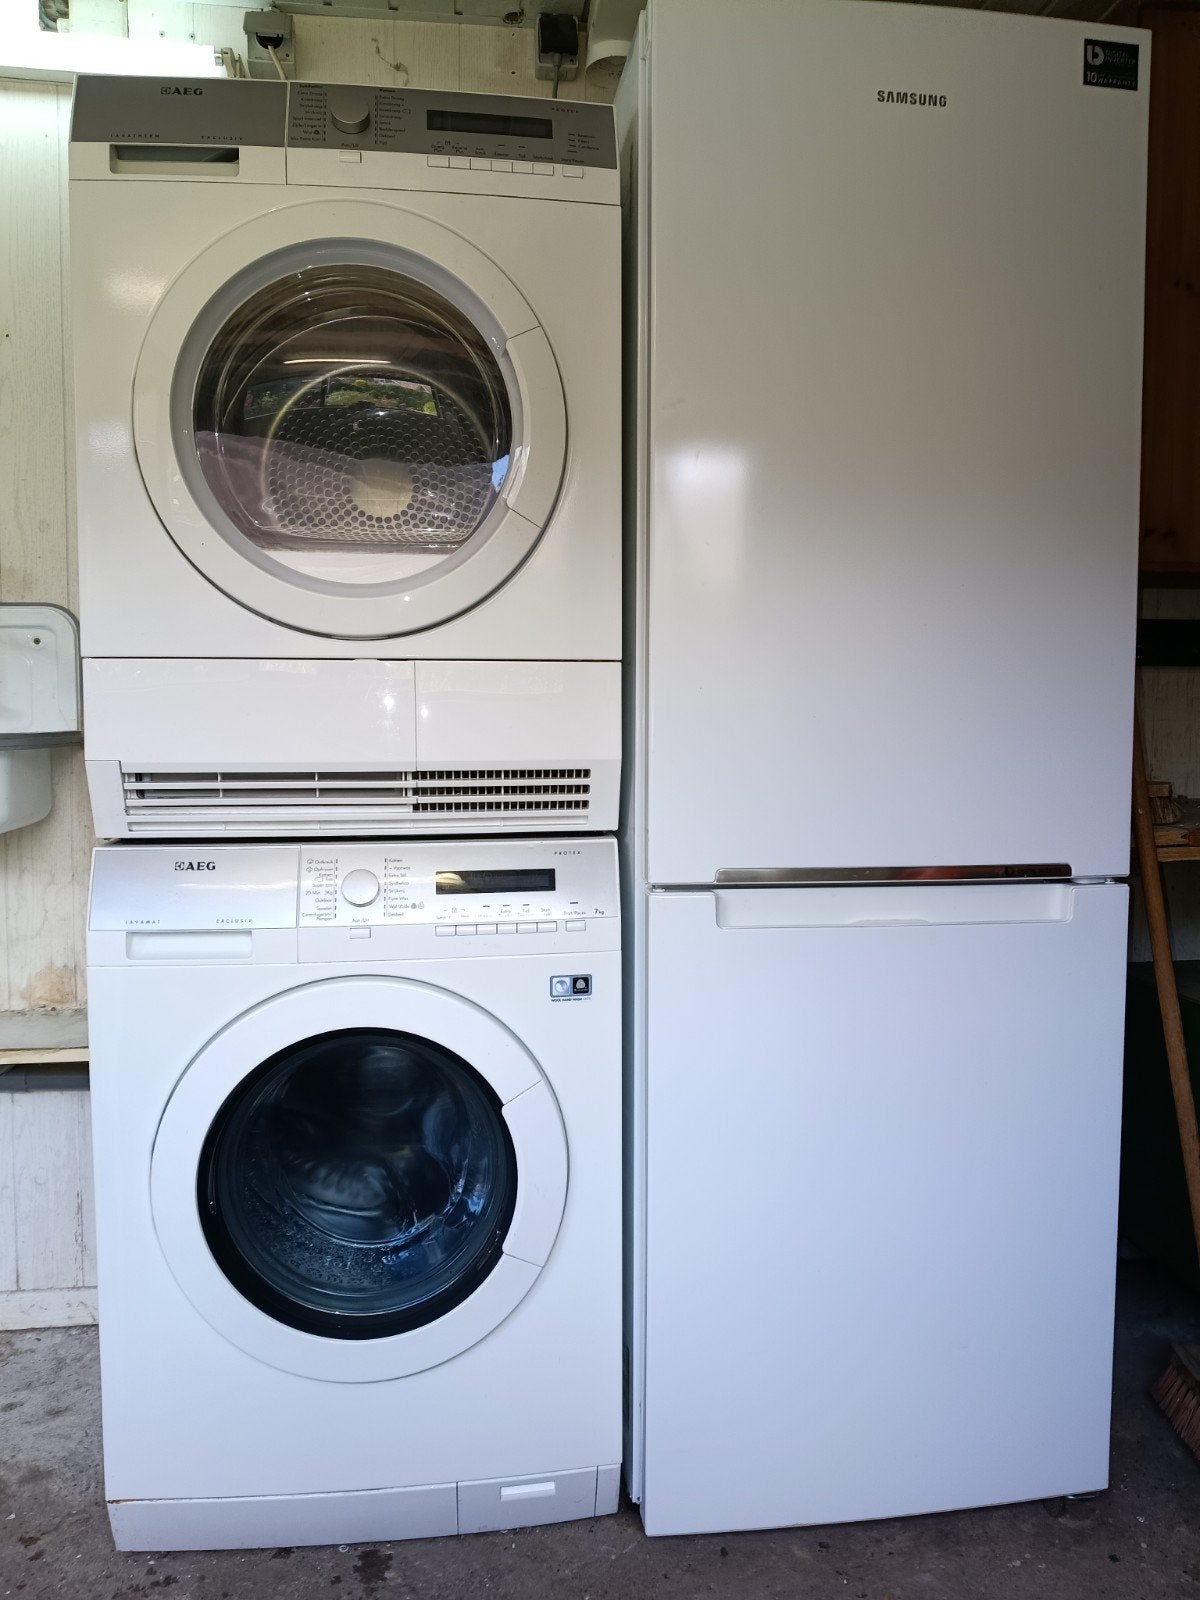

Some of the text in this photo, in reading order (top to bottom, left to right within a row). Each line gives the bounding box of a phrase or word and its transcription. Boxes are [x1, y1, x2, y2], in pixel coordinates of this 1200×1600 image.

[1086, 71, 1099, 83] 10
[171, 86, 204, 96] AEG
[877, 89, 947, 107] SAMSUNG
[186, 861, 216, 871] AEG
